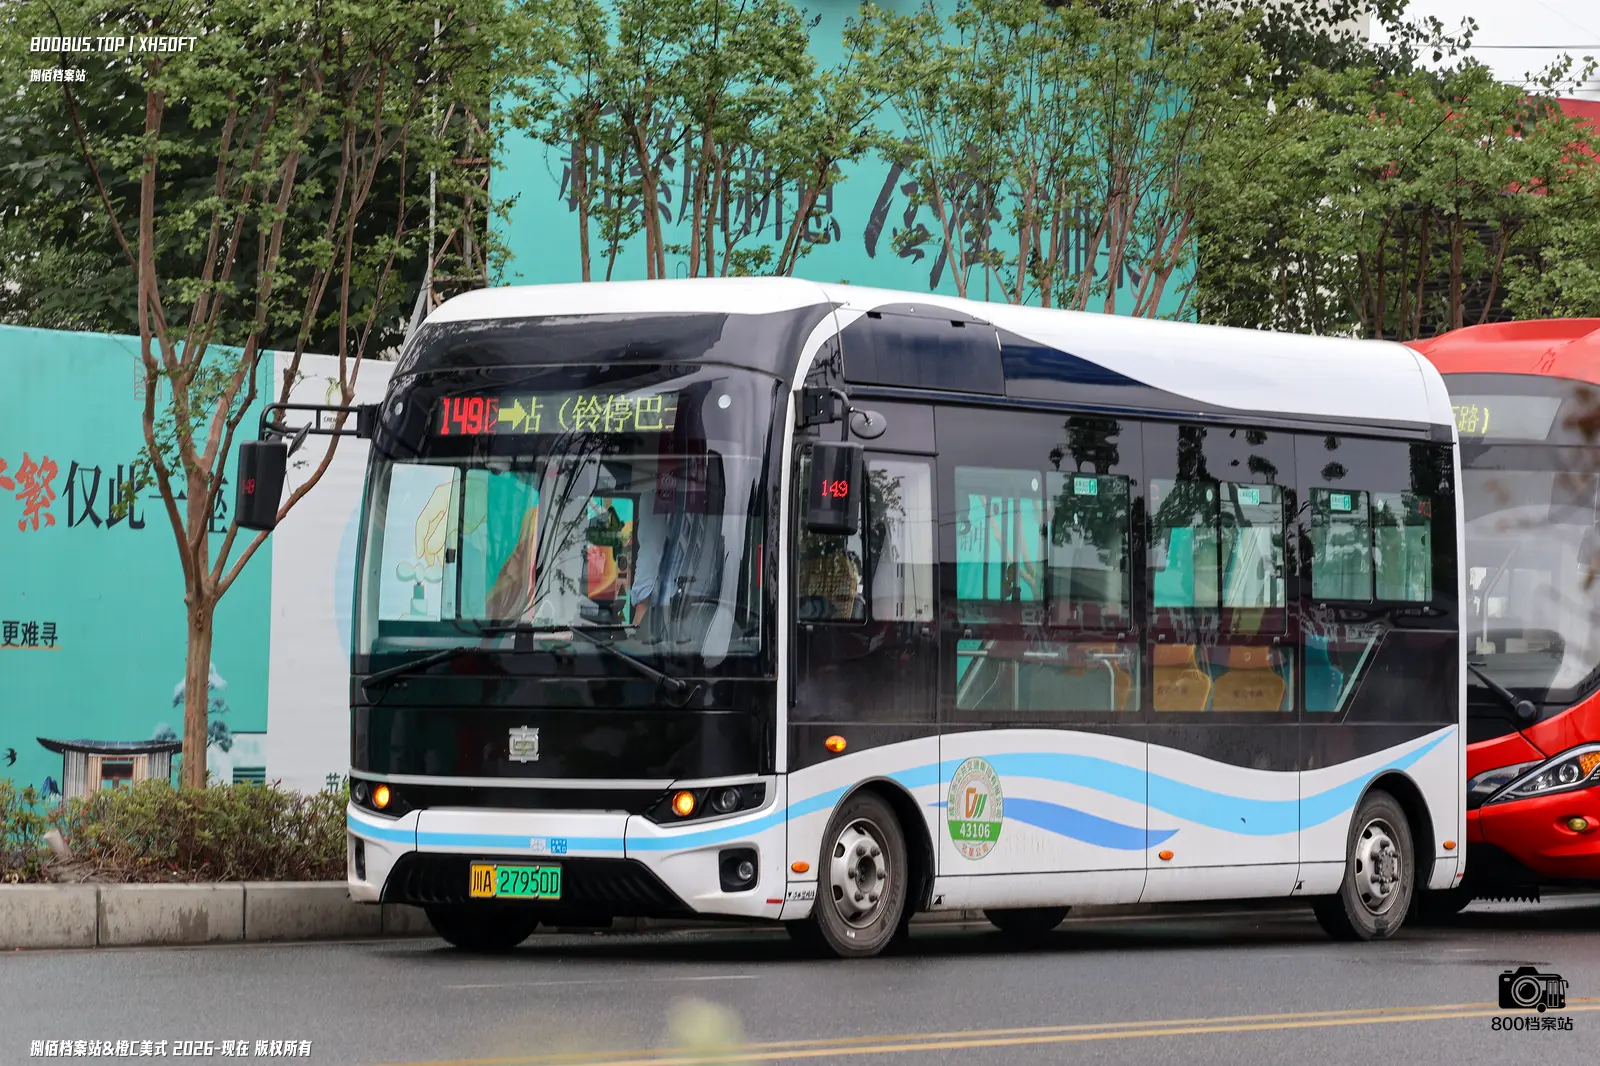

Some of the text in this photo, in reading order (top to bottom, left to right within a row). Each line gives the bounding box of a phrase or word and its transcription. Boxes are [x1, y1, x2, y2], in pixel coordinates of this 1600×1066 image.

[821, 479, 849, 497] 149
[2, 620, 58, 648] 更难寻
[326, 772, 349, 793] 节
[960, 823, 990, 839] 43106
[472, 870, 559, 894] 川A 27950D
